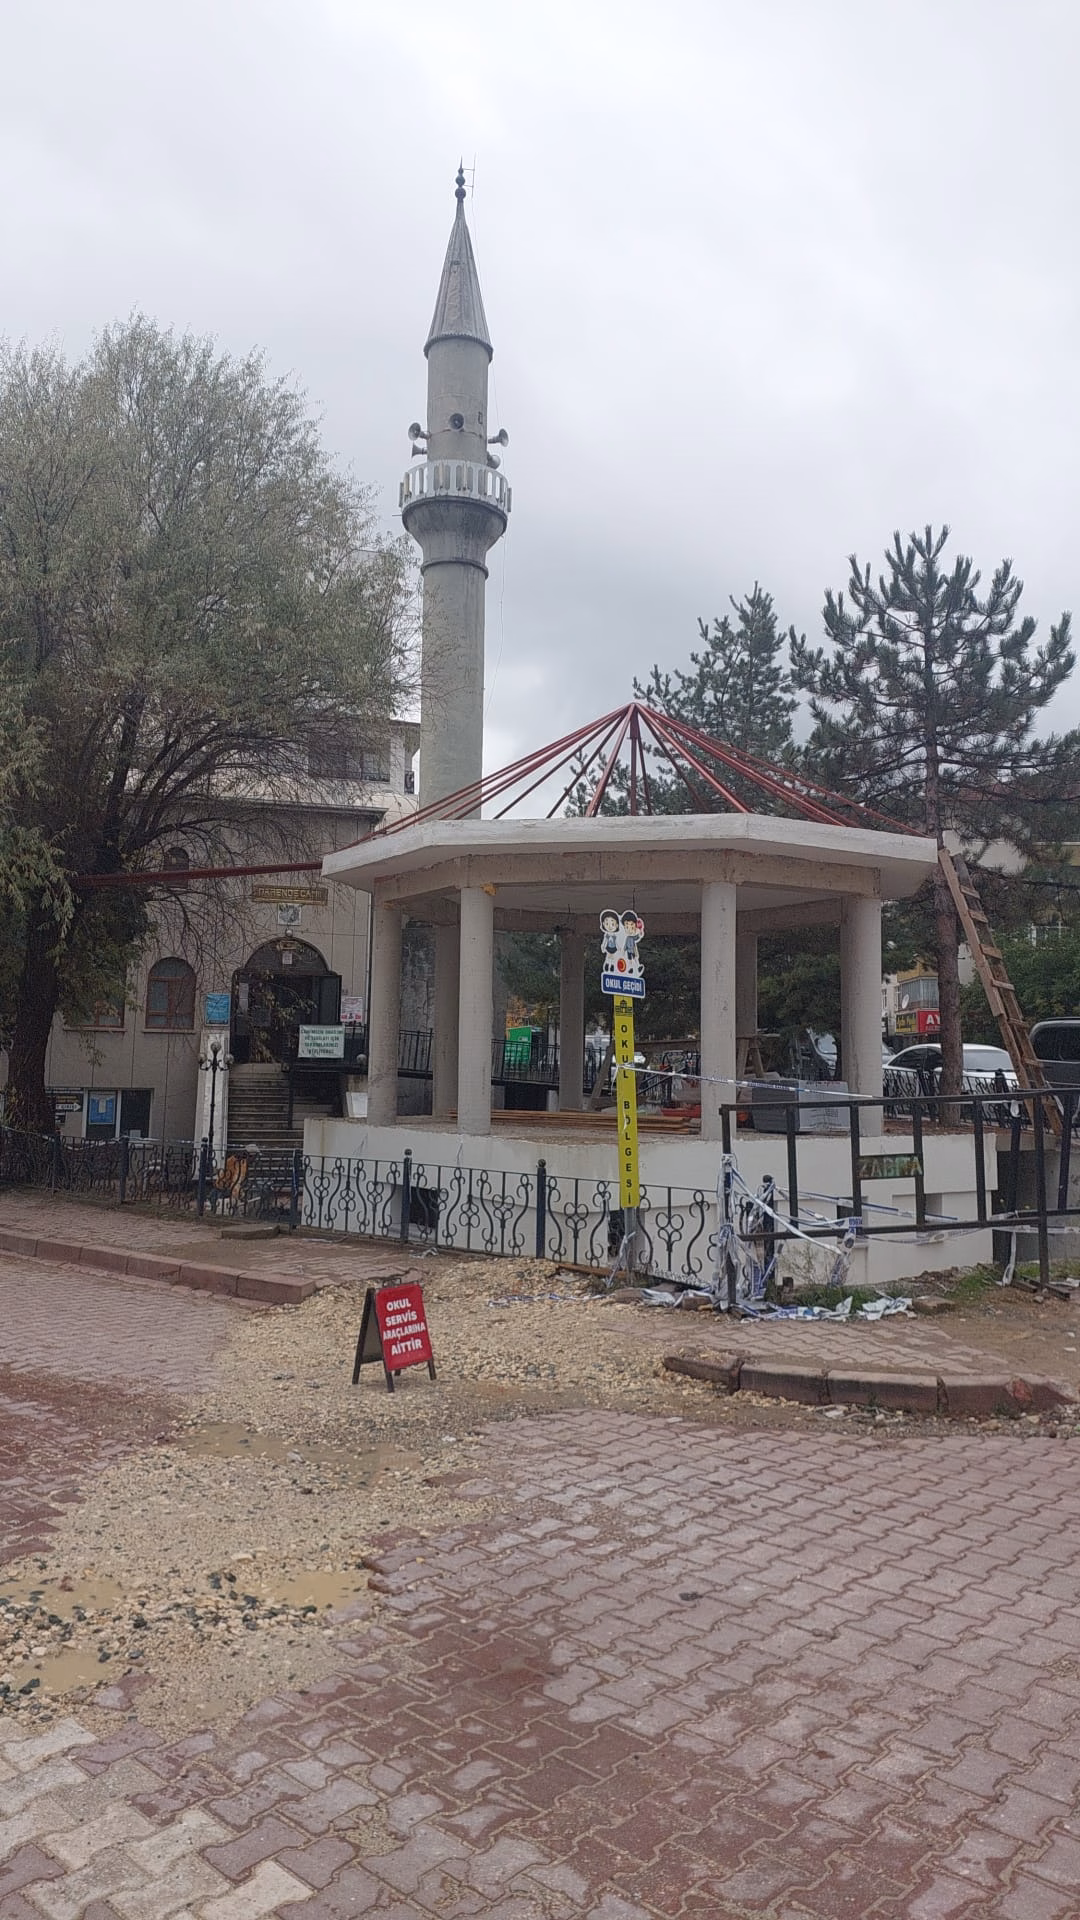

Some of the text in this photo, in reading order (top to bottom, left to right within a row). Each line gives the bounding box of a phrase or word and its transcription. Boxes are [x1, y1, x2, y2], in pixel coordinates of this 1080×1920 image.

[605, 977, 643, 994] OKUL GEÇİDİ
[620, 1024, 629, 1079] OKUL
[386, 1298, 412, 1312] OKUL
[385, 1309, 418, 1327] SERVİS
[383, 1322, 426, 1341] ARAÇLARINA
[391, 1337, 422, 1356] AİTTİR
